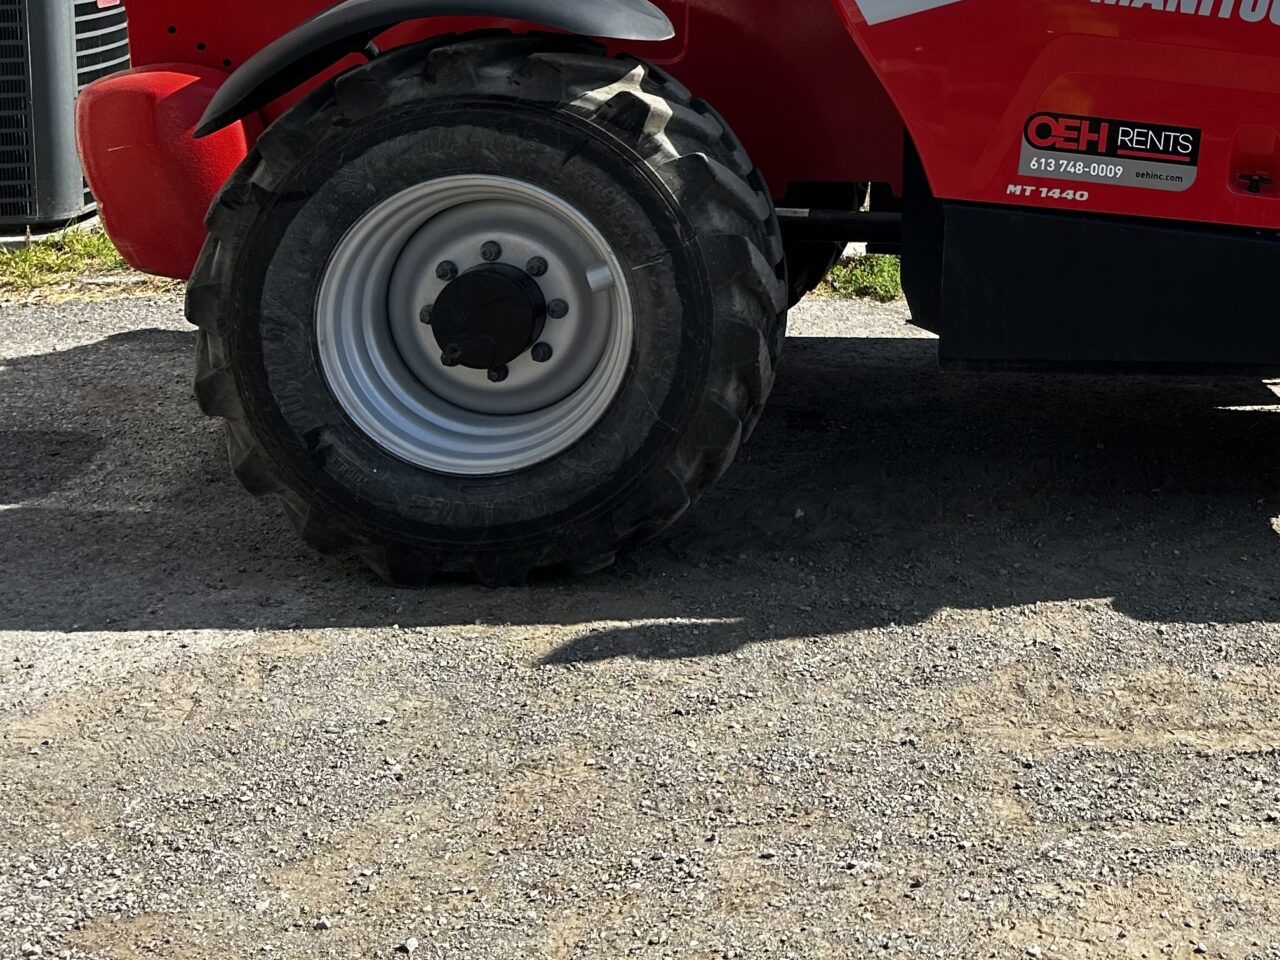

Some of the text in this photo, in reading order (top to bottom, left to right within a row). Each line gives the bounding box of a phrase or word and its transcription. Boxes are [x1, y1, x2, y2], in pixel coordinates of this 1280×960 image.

[1027, 115, 1193, 154] OEH RENTS
[1030, 157, 1183, 183] 613 748-0009 oehinc.com
[1006, 184, 1089, 201] MT 1440
